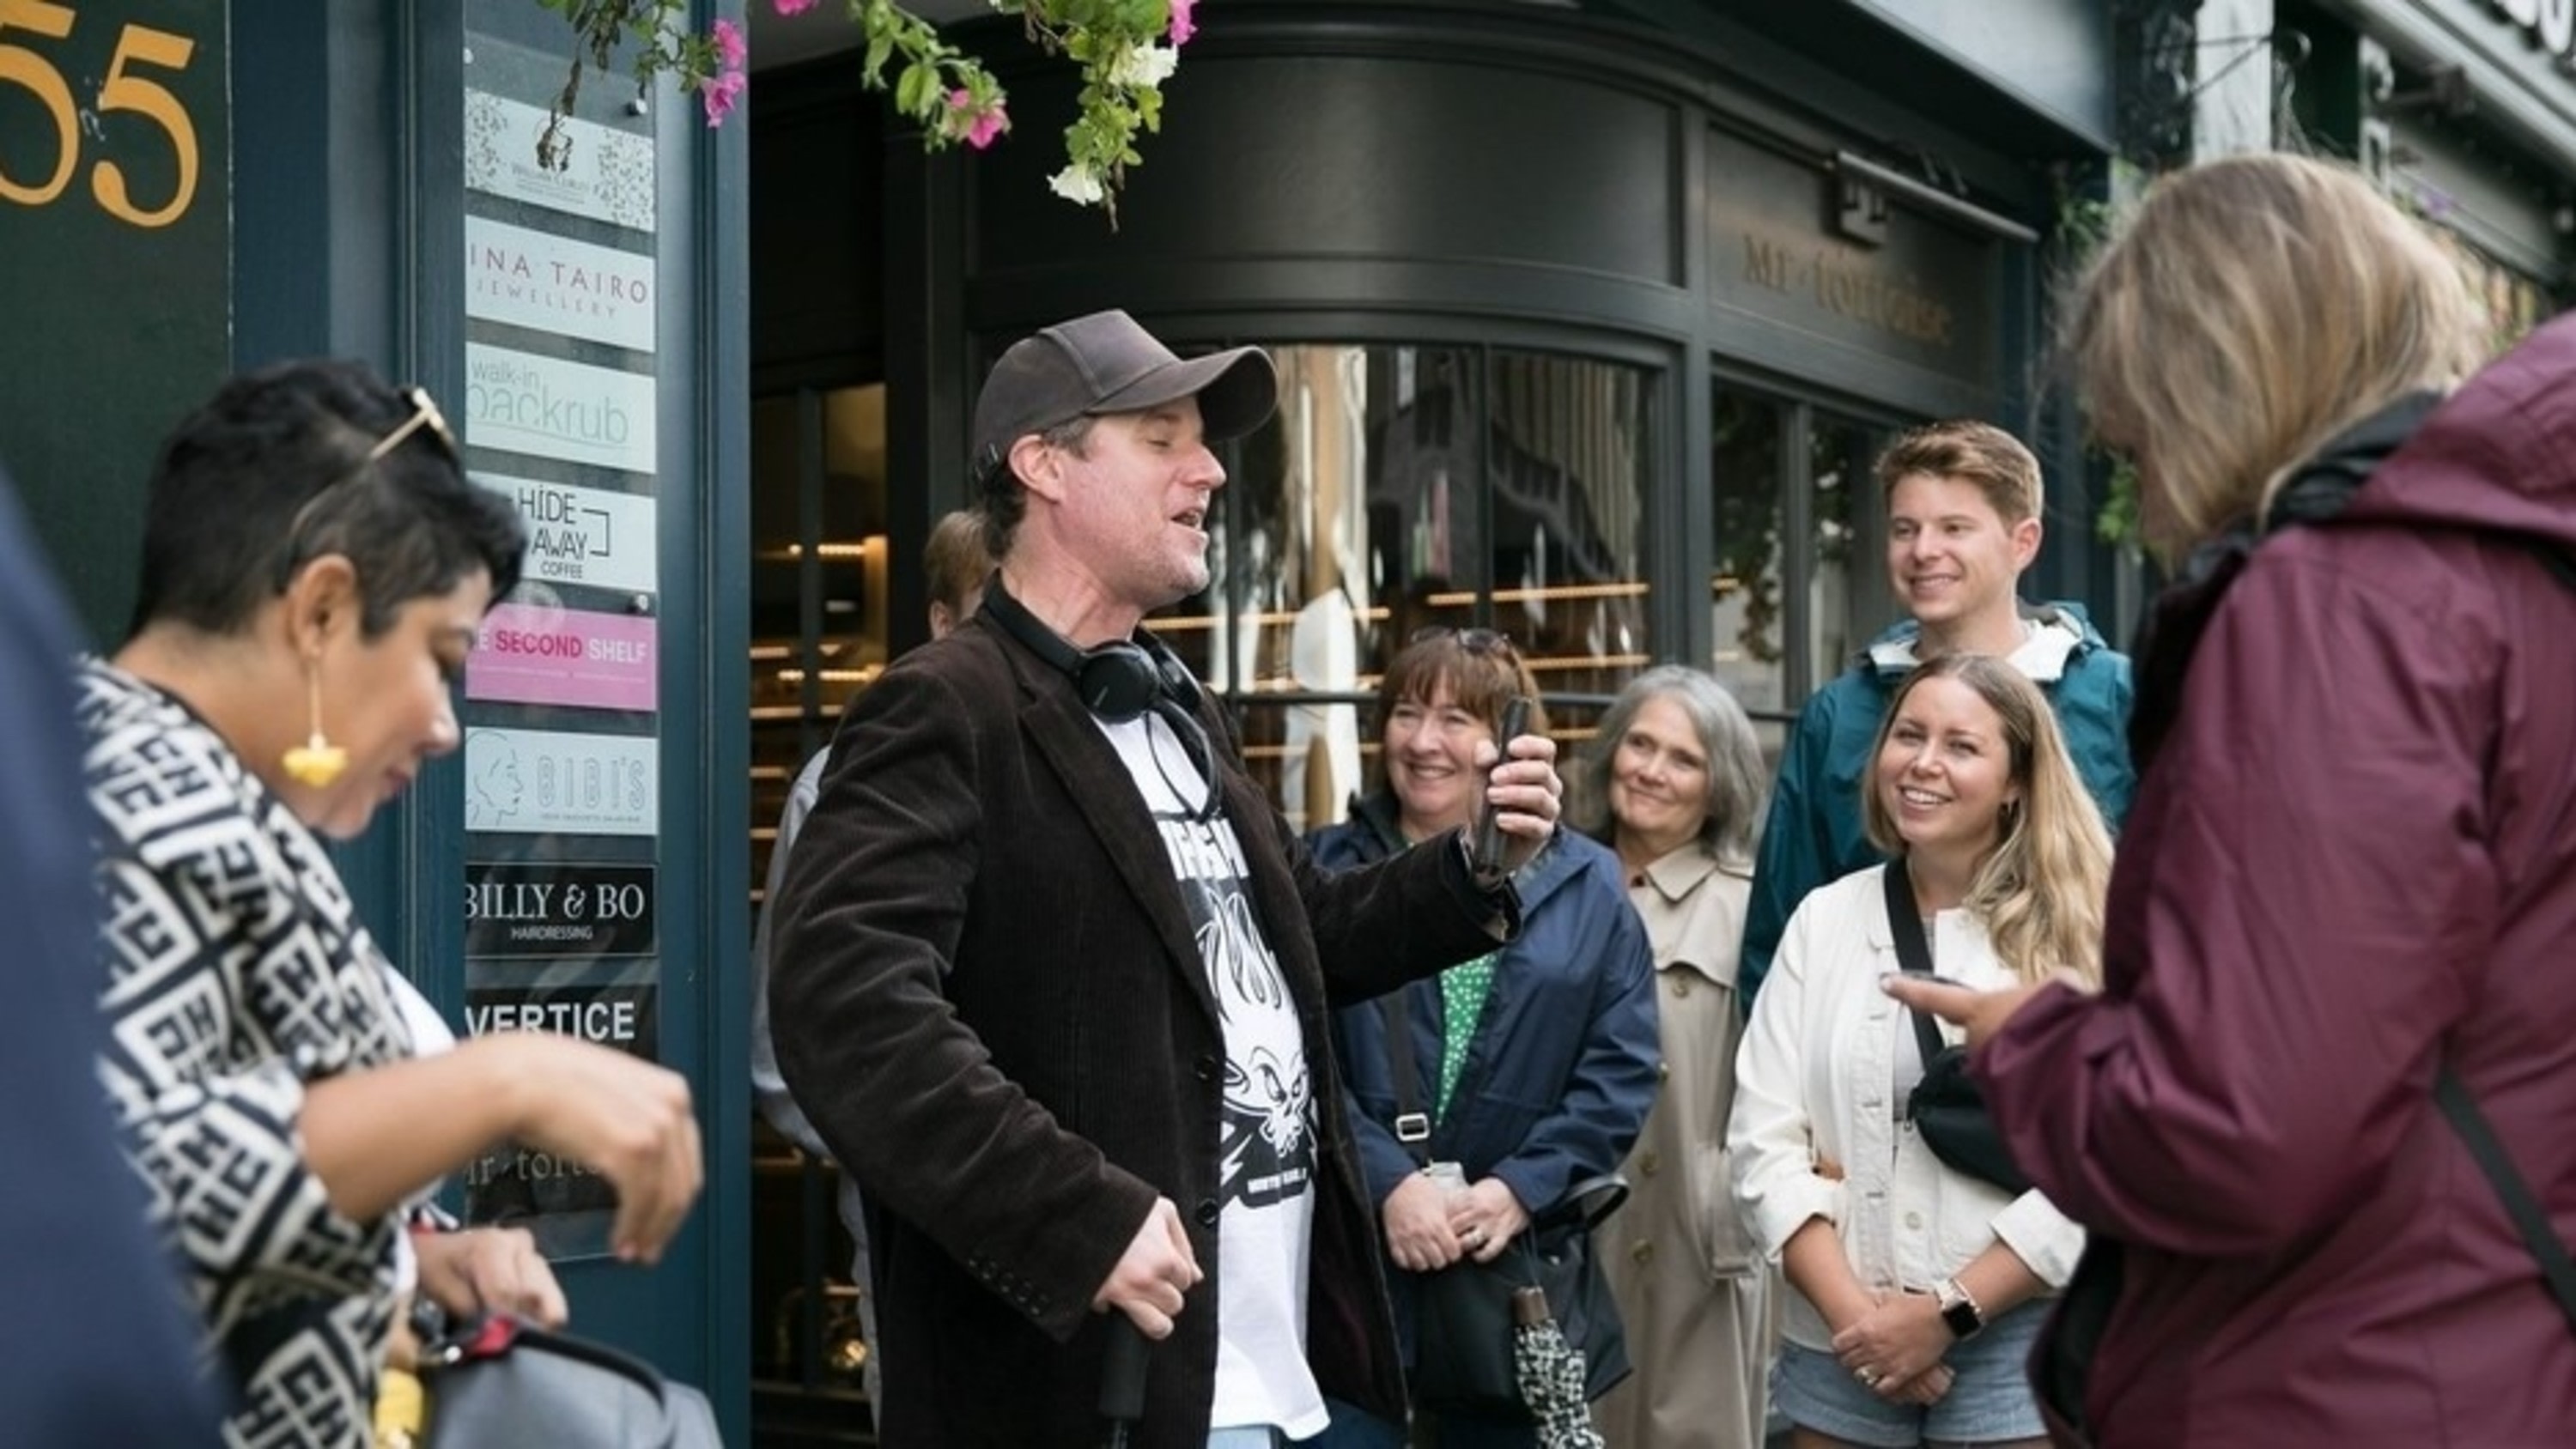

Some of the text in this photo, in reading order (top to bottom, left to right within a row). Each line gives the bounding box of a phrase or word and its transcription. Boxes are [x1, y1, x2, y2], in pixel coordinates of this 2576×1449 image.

[476, 279, 616, 318] JEWELLERY
[550, 261, 647, 304] TAIRO
[471, 360, 539, 387] walk-in
[531, 528, 587, 561] AWAY
[540, 561, 584, 579] COFFEE
[495, 629, 583, 658] SECOND
[588, 638, 647, 664] SHELF
[537, 754, 646, 810] BIBI'S
[465, 883, 645, 919] BILLY & BO
[510, 925, 593, 941] HAIRDRESSING
[465, 1001, 635, 1040] VERTICE
